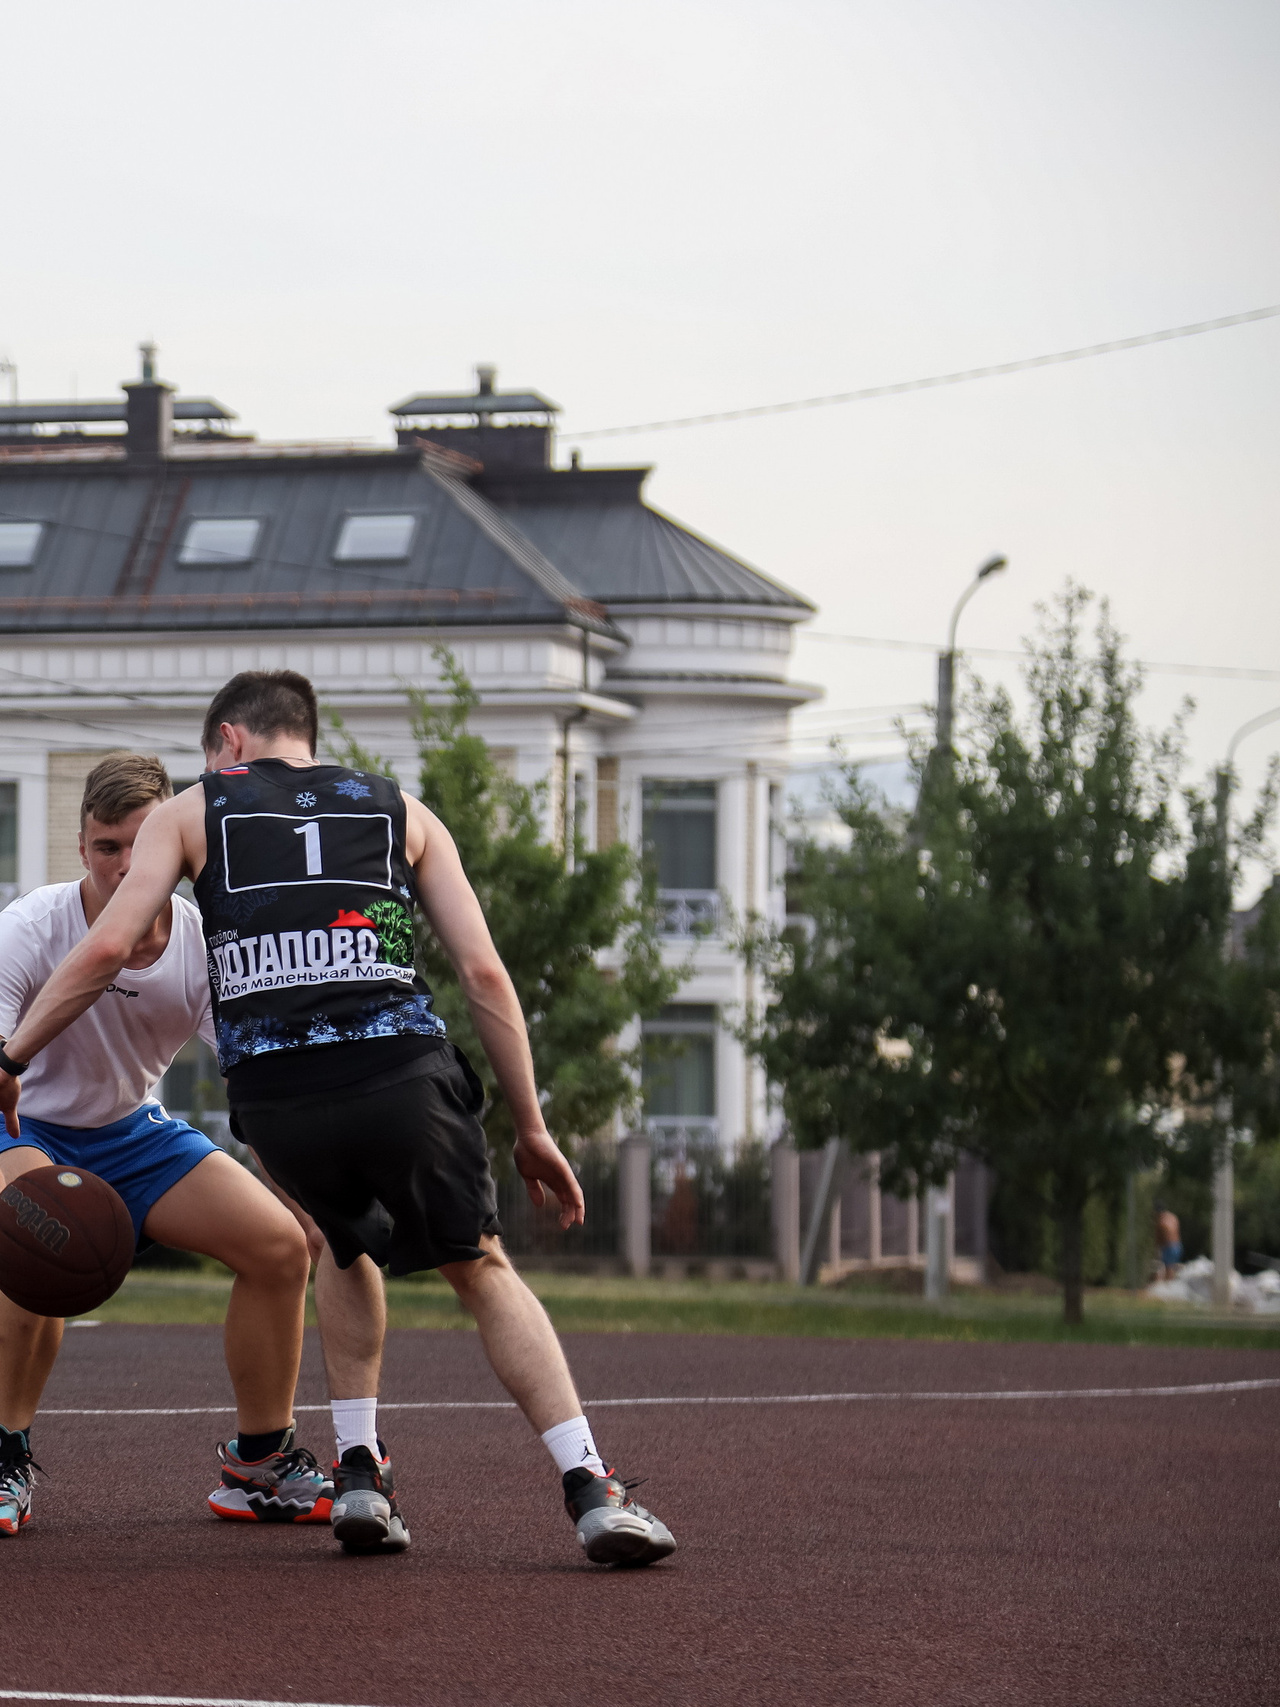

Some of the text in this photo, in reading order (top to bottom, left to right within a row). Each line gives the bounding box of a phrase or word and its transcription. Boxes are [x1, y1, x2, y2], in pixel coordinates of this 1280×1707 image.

[294, 822, 324, 876] 1
[212, 928, 379, 984] ПОТАПОВО
[221, 965, 413, 998] Моя маленькая Москва
